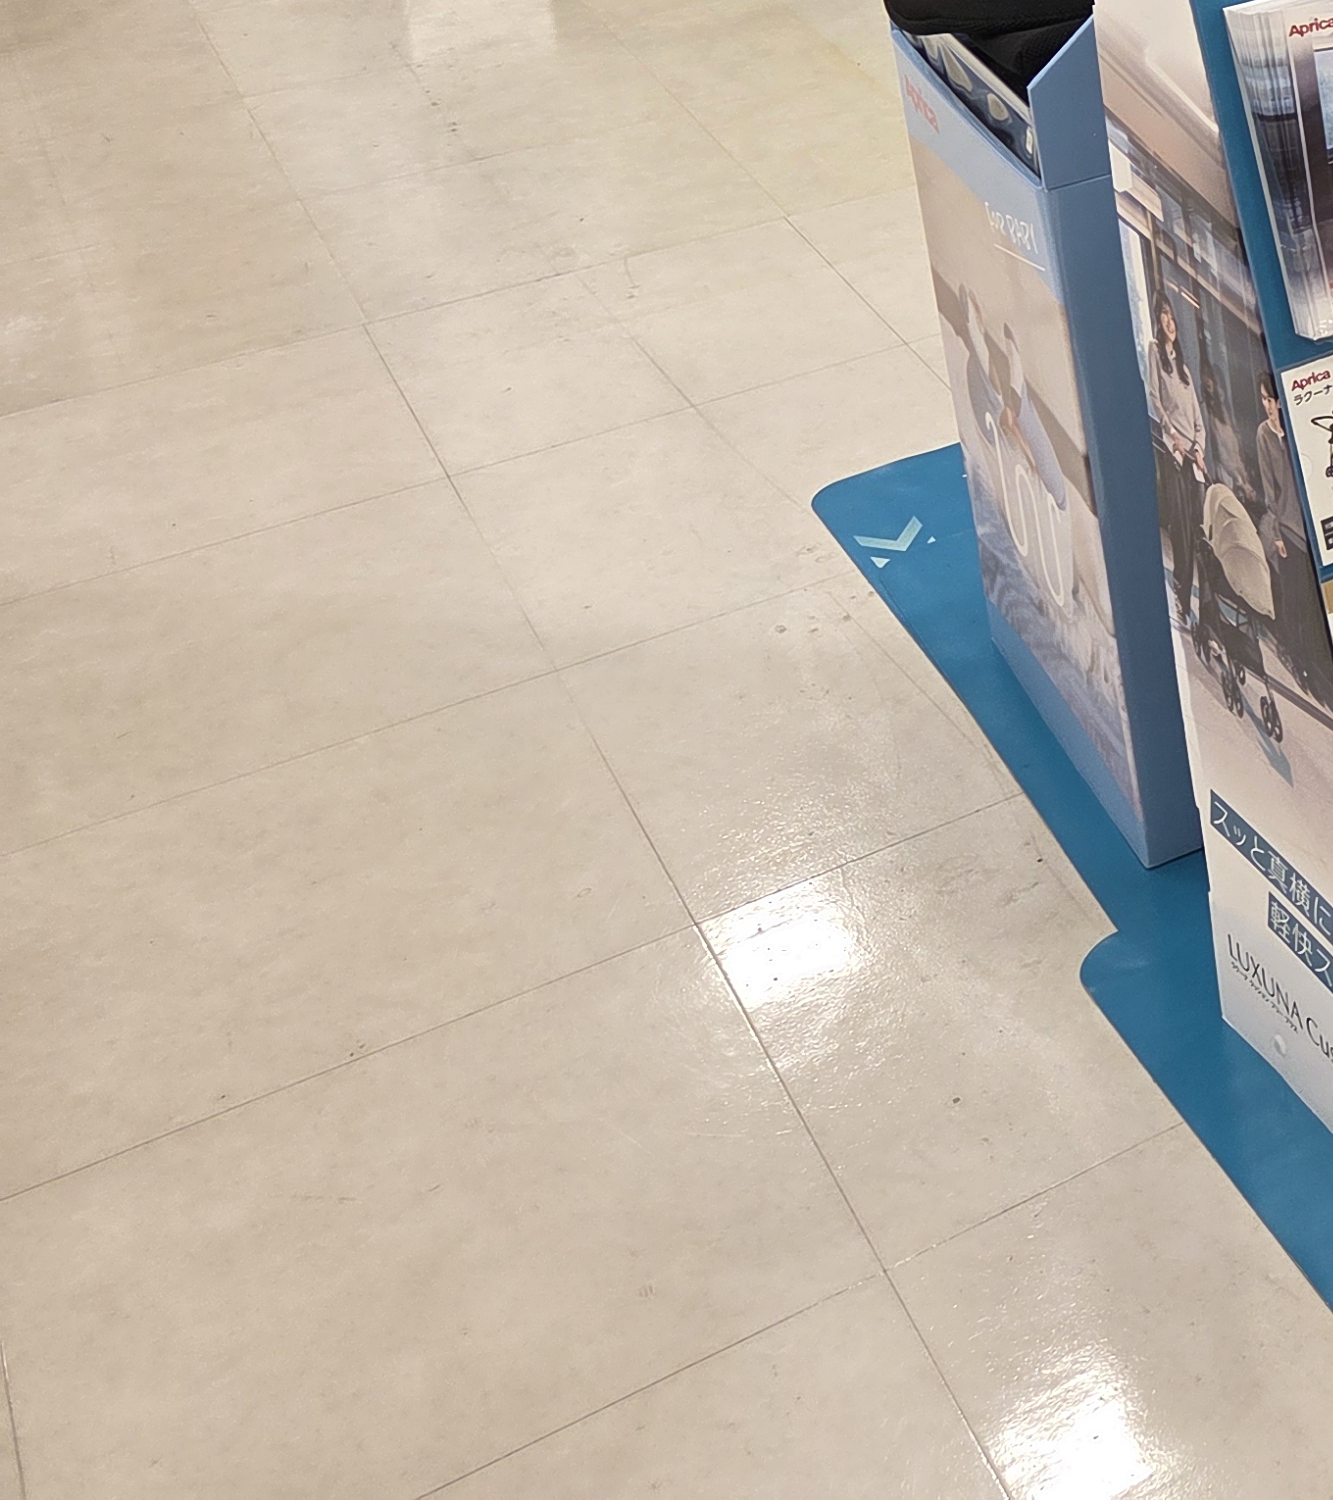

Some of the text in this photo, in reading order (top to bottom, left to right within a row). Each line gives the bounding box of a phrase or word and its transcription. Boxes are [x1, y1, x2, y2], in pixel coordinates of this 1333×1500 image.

[1291, 368, 1332, 392] Aprica
[1212, 800, 1332, 936] スッと真横に
[1227, 933, 1304, 1031] LUXUNA
